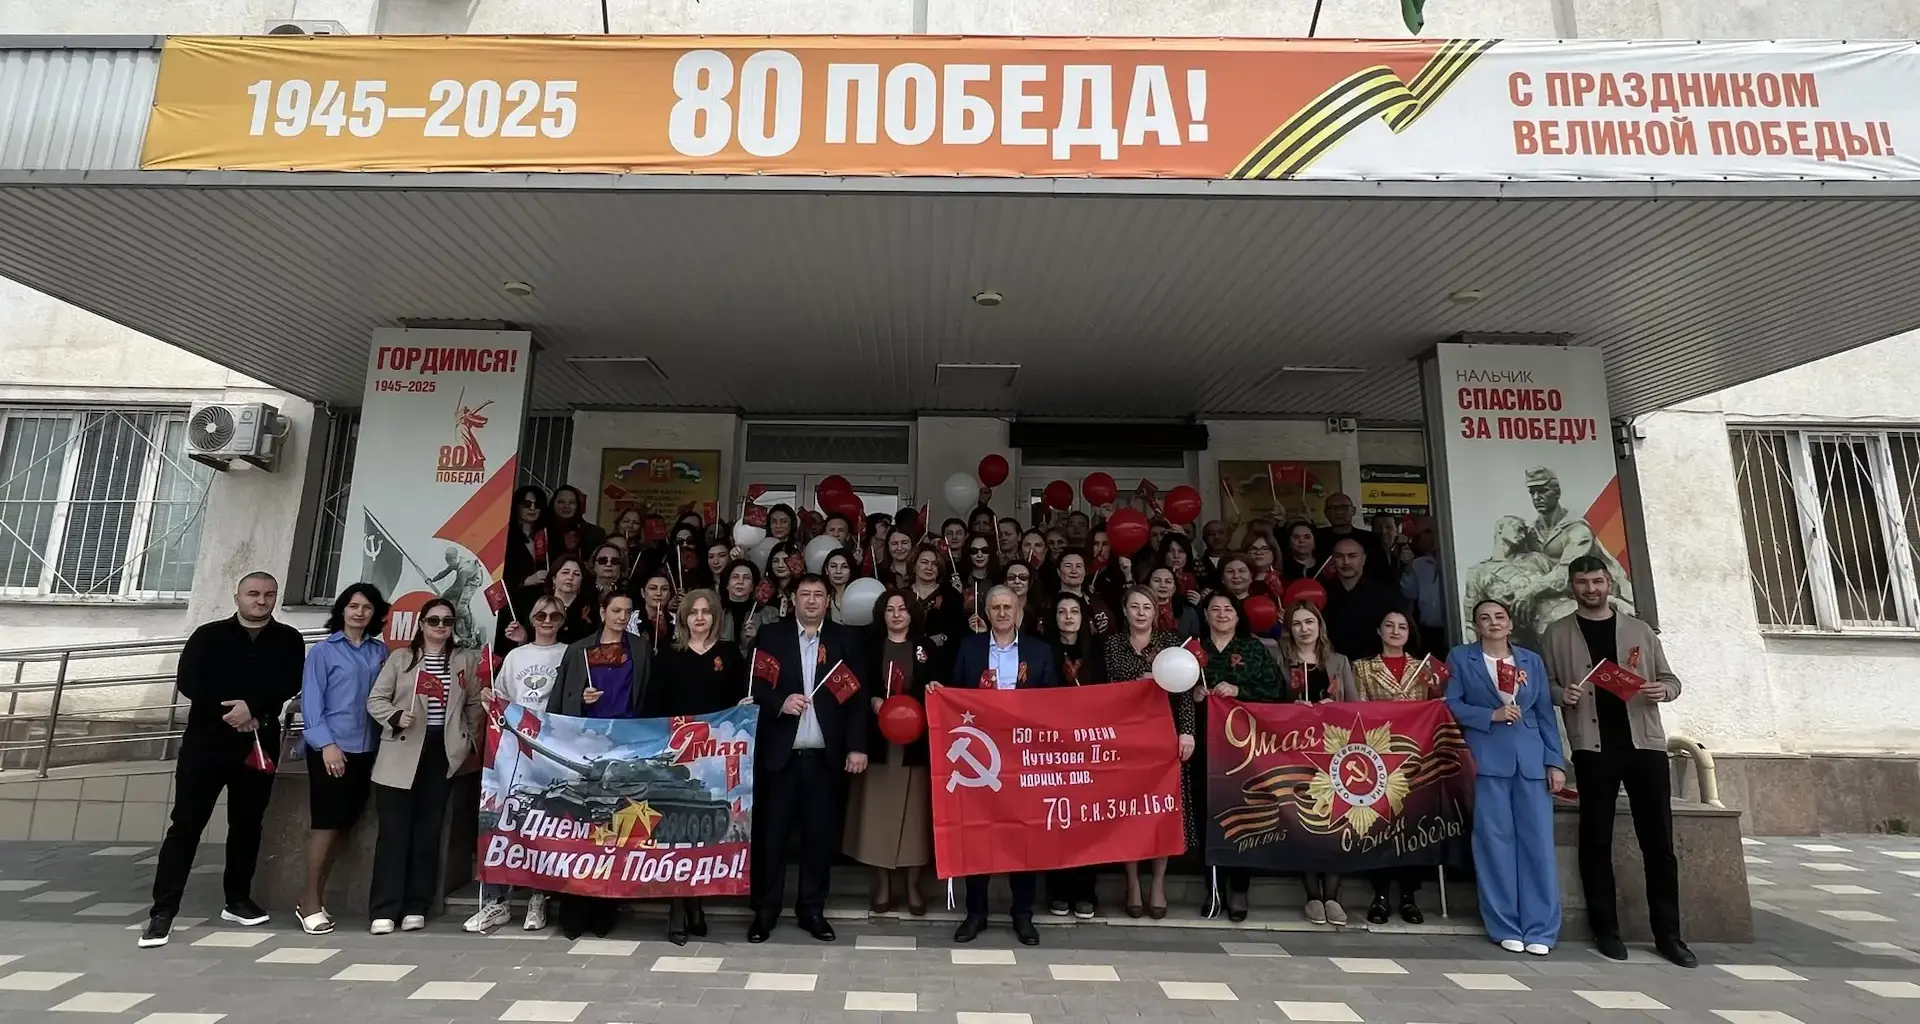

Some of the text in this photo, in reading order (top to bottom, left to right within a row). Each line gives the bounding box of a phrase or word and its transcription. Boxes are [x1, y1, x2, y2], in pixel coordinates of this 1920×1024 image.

[669, 49, 1209, 160] 80 ПОБЕДА!
[1508, 71, 1820, 113] С ПРАЗДНИКОМ
[1513, 116, 1895, 161] ВЕЛИКОЙ ПОБЕДЫ!
[376, 346, 517, 375] ГОРДИМСЯ!
[1456, 369, 1534, 383] НАЛЬЧИК
[1458, 388, 1562, 411] СПАСИБО
[1460, 417, 1597, 444] ЗА ПОБЕДУ!
[438, 445, 467, 467] 80
[436, 471, 484, 484] ПОБЕДА!
[667, 721, 748, 765] 9 Мая
[1012, 727, 1033, 744] 150
[1224, 706, 1321, 776] 9 мая
[498, 798, 521, 832] С
[1043, 796, 1071, 831] 79
[484, 835, 747, 886] Великой Победы!
